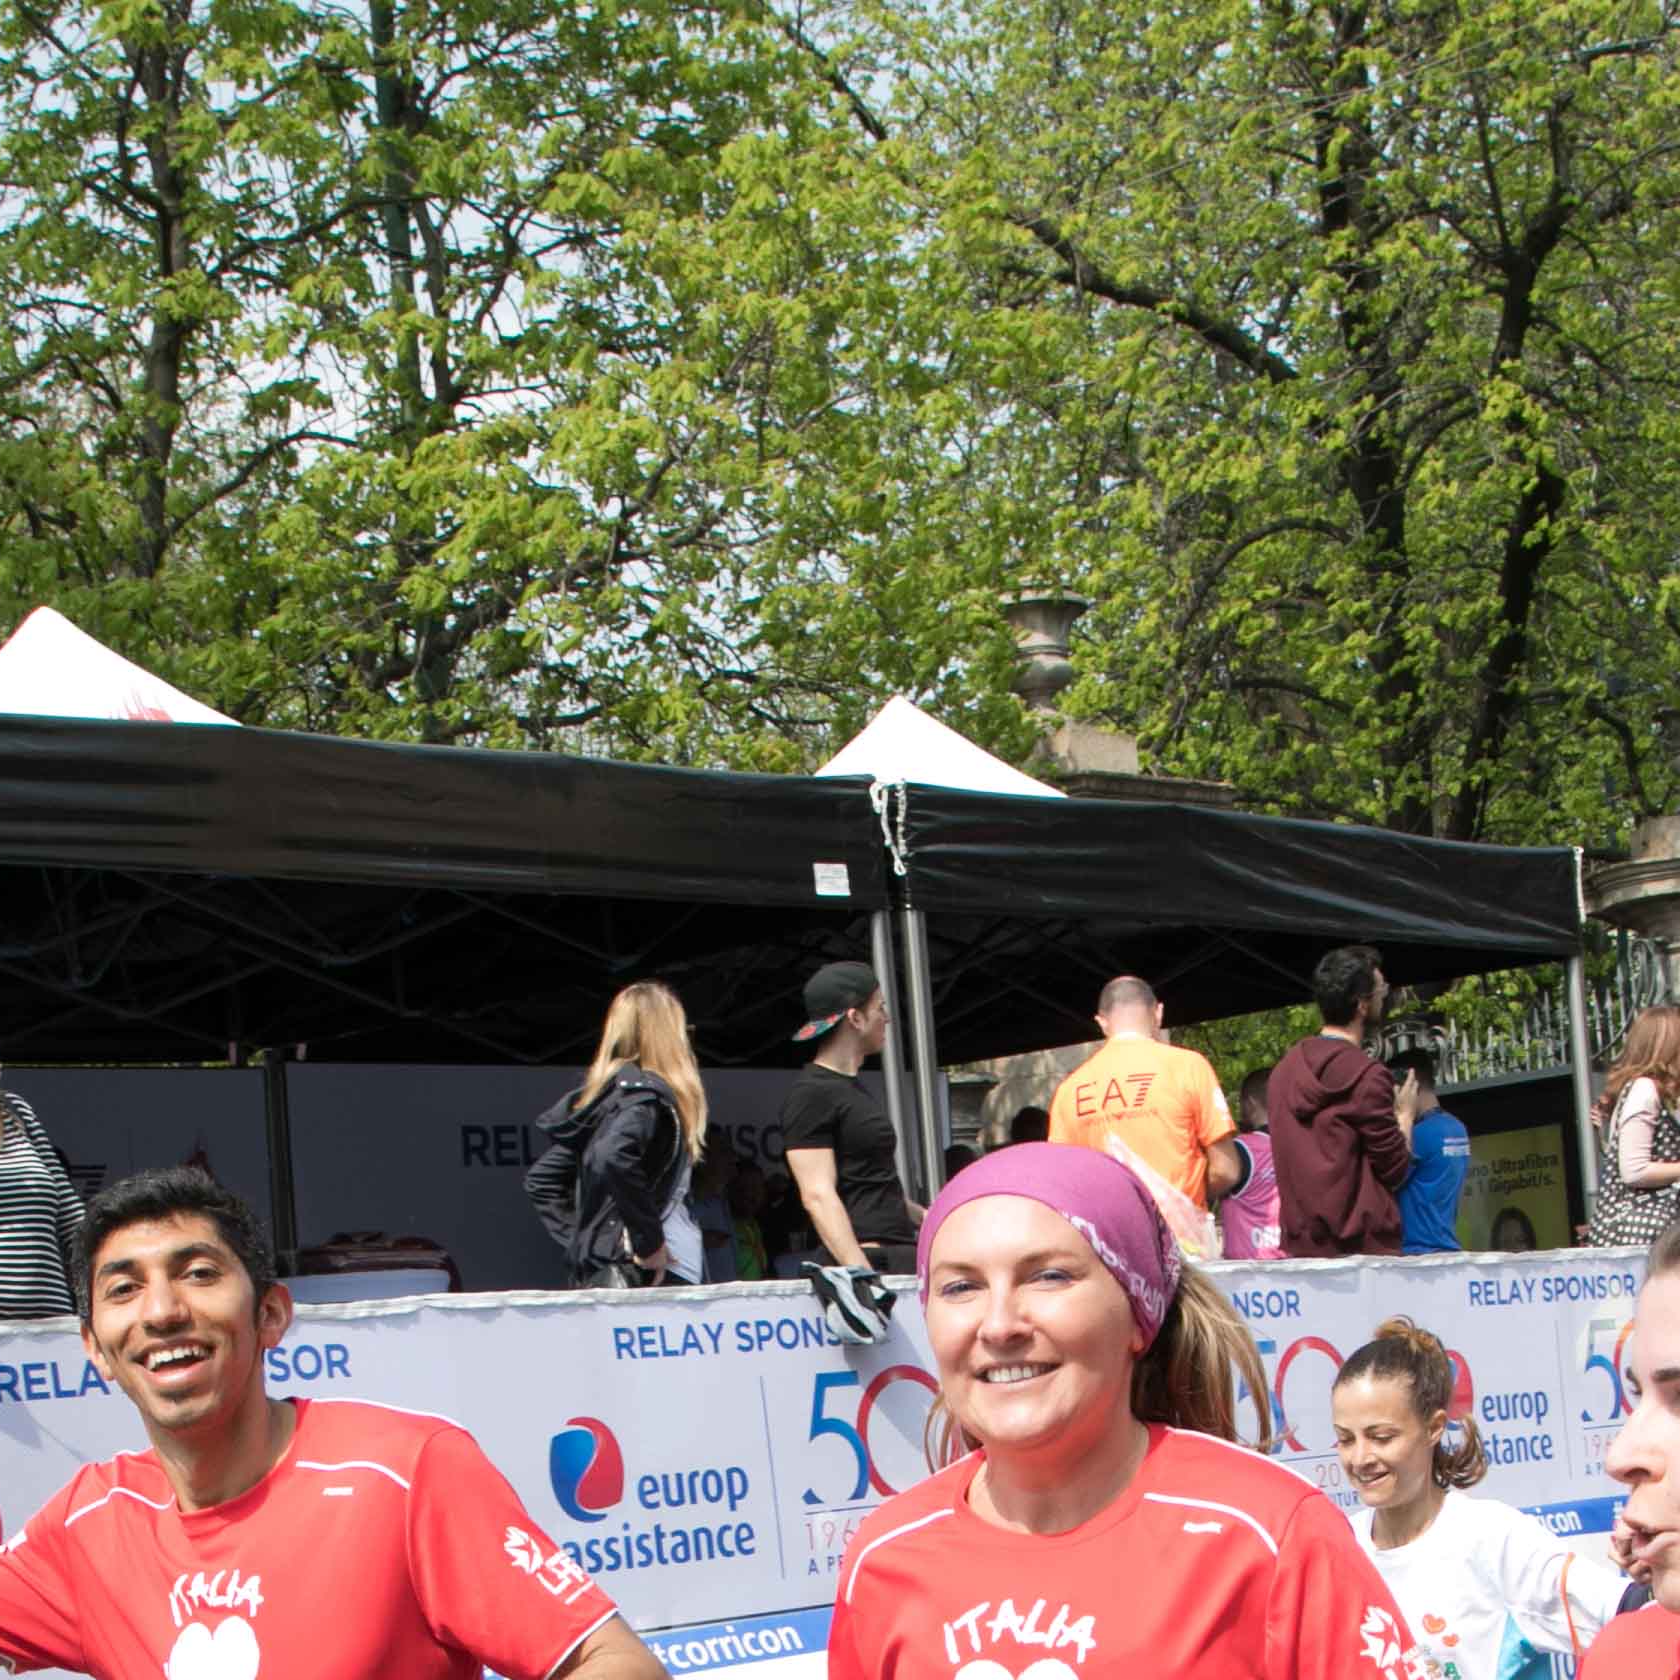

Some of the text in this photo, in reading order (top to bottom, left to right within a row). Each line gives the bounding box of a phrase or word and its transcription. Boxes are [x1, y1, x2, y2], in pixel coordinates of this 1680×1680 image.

[1075, 1073, 1157, 1117] EA7
[460, 1124, 534, 1168] REL
[1233, 1289, 1300, 1319] NSOR
[1468, 1273, 1636, 1306] RELAY SPONSOR
[614, 1322, 723, 1362] RELAY
[1482, 1390, 1549, 1426] europ
[638, 1465, 749, 1512] europ
[561, 1520, 756, 1575] assistance
[168, 1569, 264, 1626] ITALIA
[943, 1599, 1096, 1664] ITALIA
